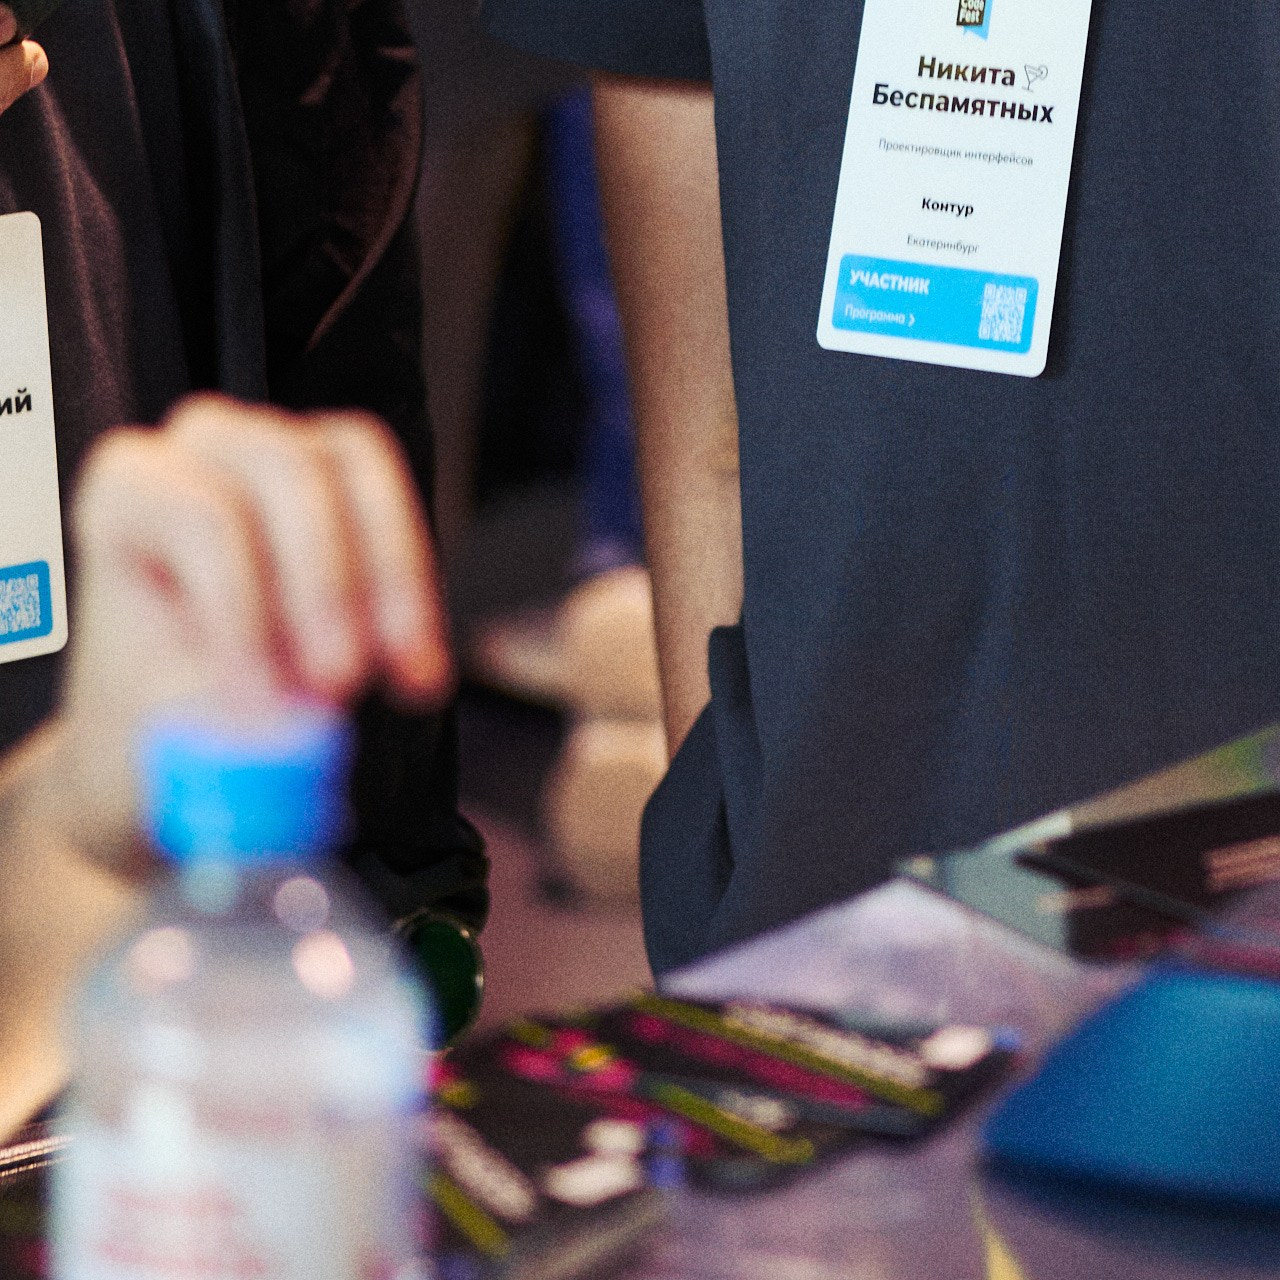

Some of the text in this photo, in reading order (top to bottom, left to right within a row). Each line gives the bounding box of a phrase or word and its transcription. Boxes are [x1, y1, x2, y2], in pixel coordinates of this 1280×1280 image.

[917, 55, 1016, 87] Никита
[872, 82, 1055, 124] Беспамятных
[878, 137, 1034, 168] Проектировщик интерфейсов
[921, 197, 975, 218] Контур
[906, 234, 980, 256] Екатеринбург
[849, 269, 931, 295] УЧАСТНИК
[844, 303, 907, 326] Программа
